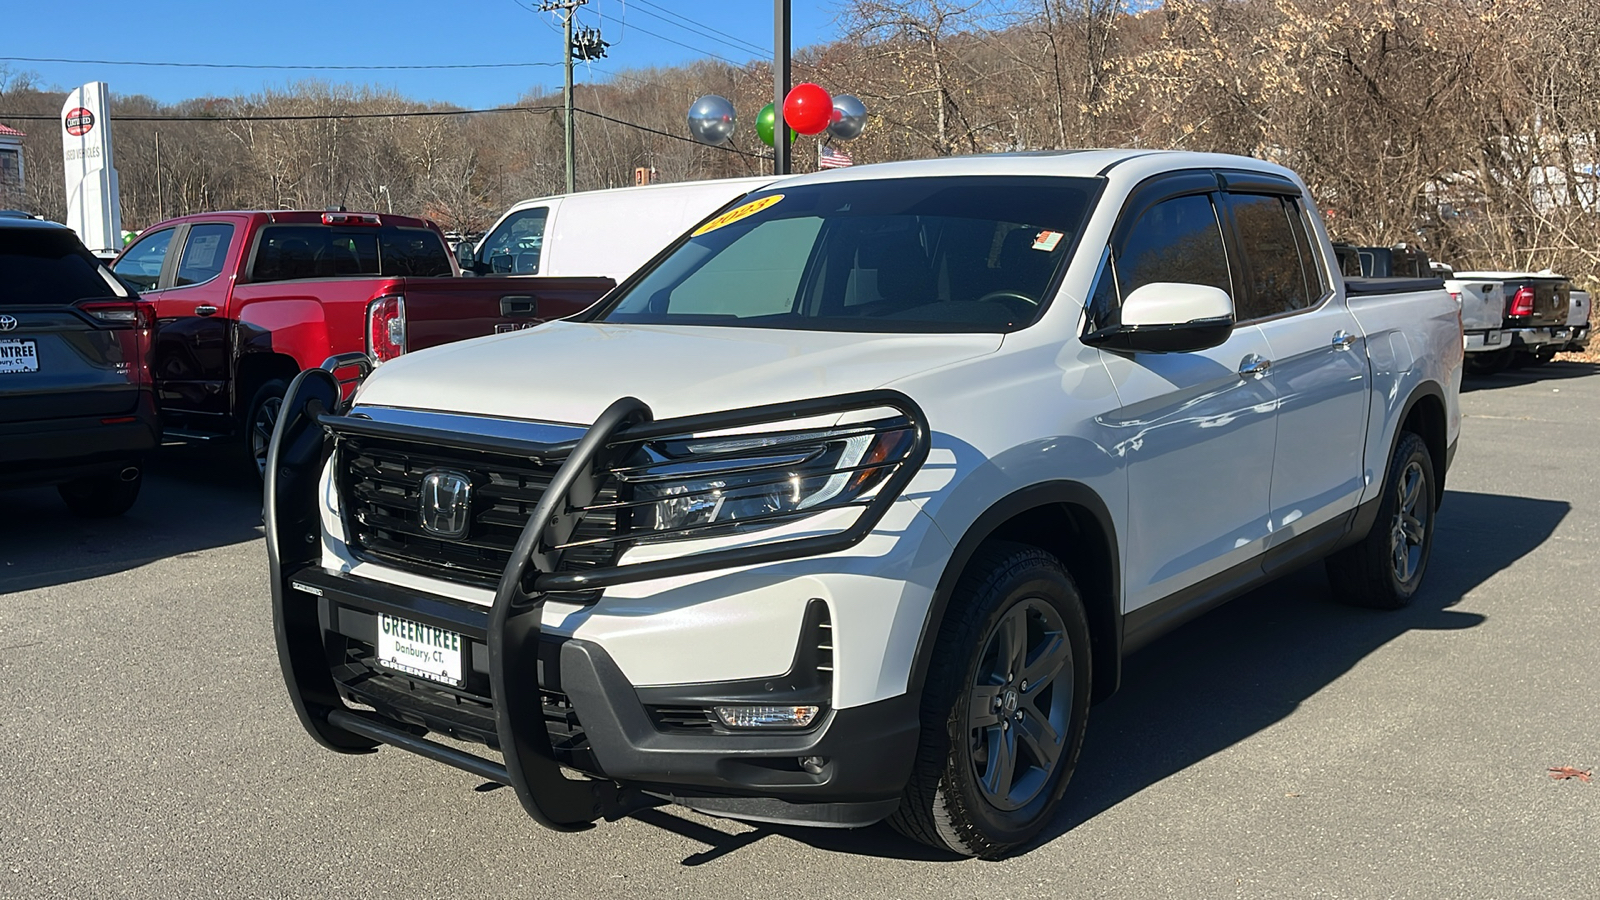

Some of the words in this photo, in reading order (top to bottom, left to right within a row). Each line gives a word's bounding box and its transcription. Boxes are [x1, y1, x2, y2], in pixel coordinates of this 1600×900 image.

[703, 199, 770, 233] 2023
[382, 614, 459, 652] GREENTREE
[395, 640, 431, 663] Danbury,
[432, 650, 444, 664] CT.
